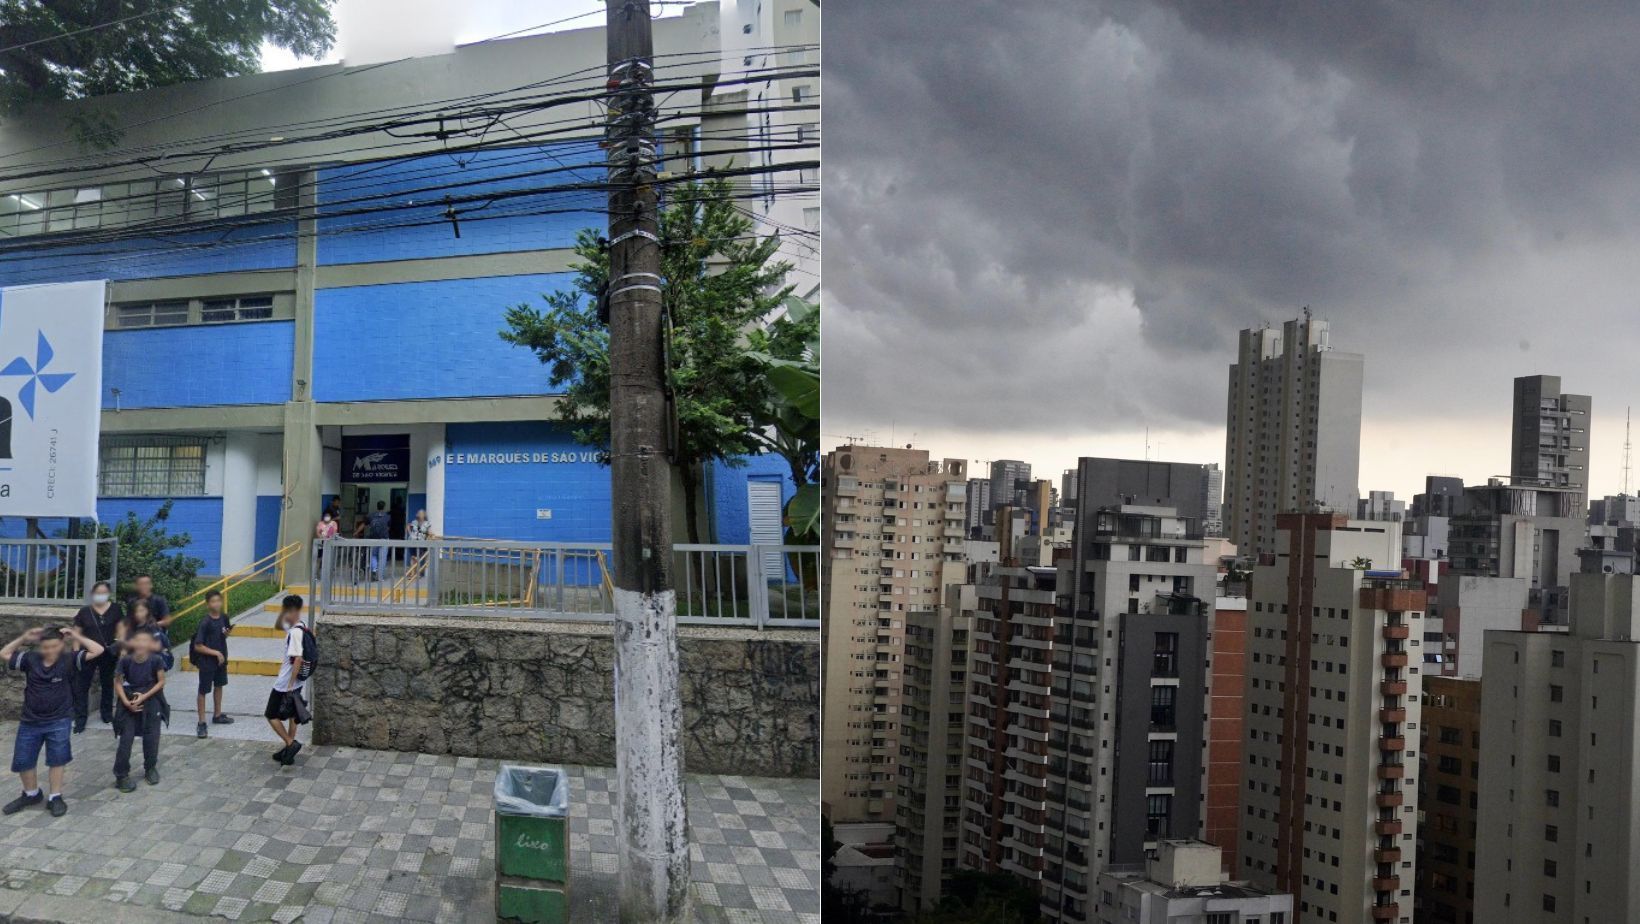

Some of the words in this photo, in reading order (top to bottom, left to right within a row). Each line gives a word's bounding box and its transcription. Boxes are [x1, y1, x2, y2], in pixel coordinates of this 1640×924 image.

[446, 454, 454, 464] E
[457, 454, 464, 464] E
[533, 452, 549, 463] DE
[514, 832, 549, 850] lixo
